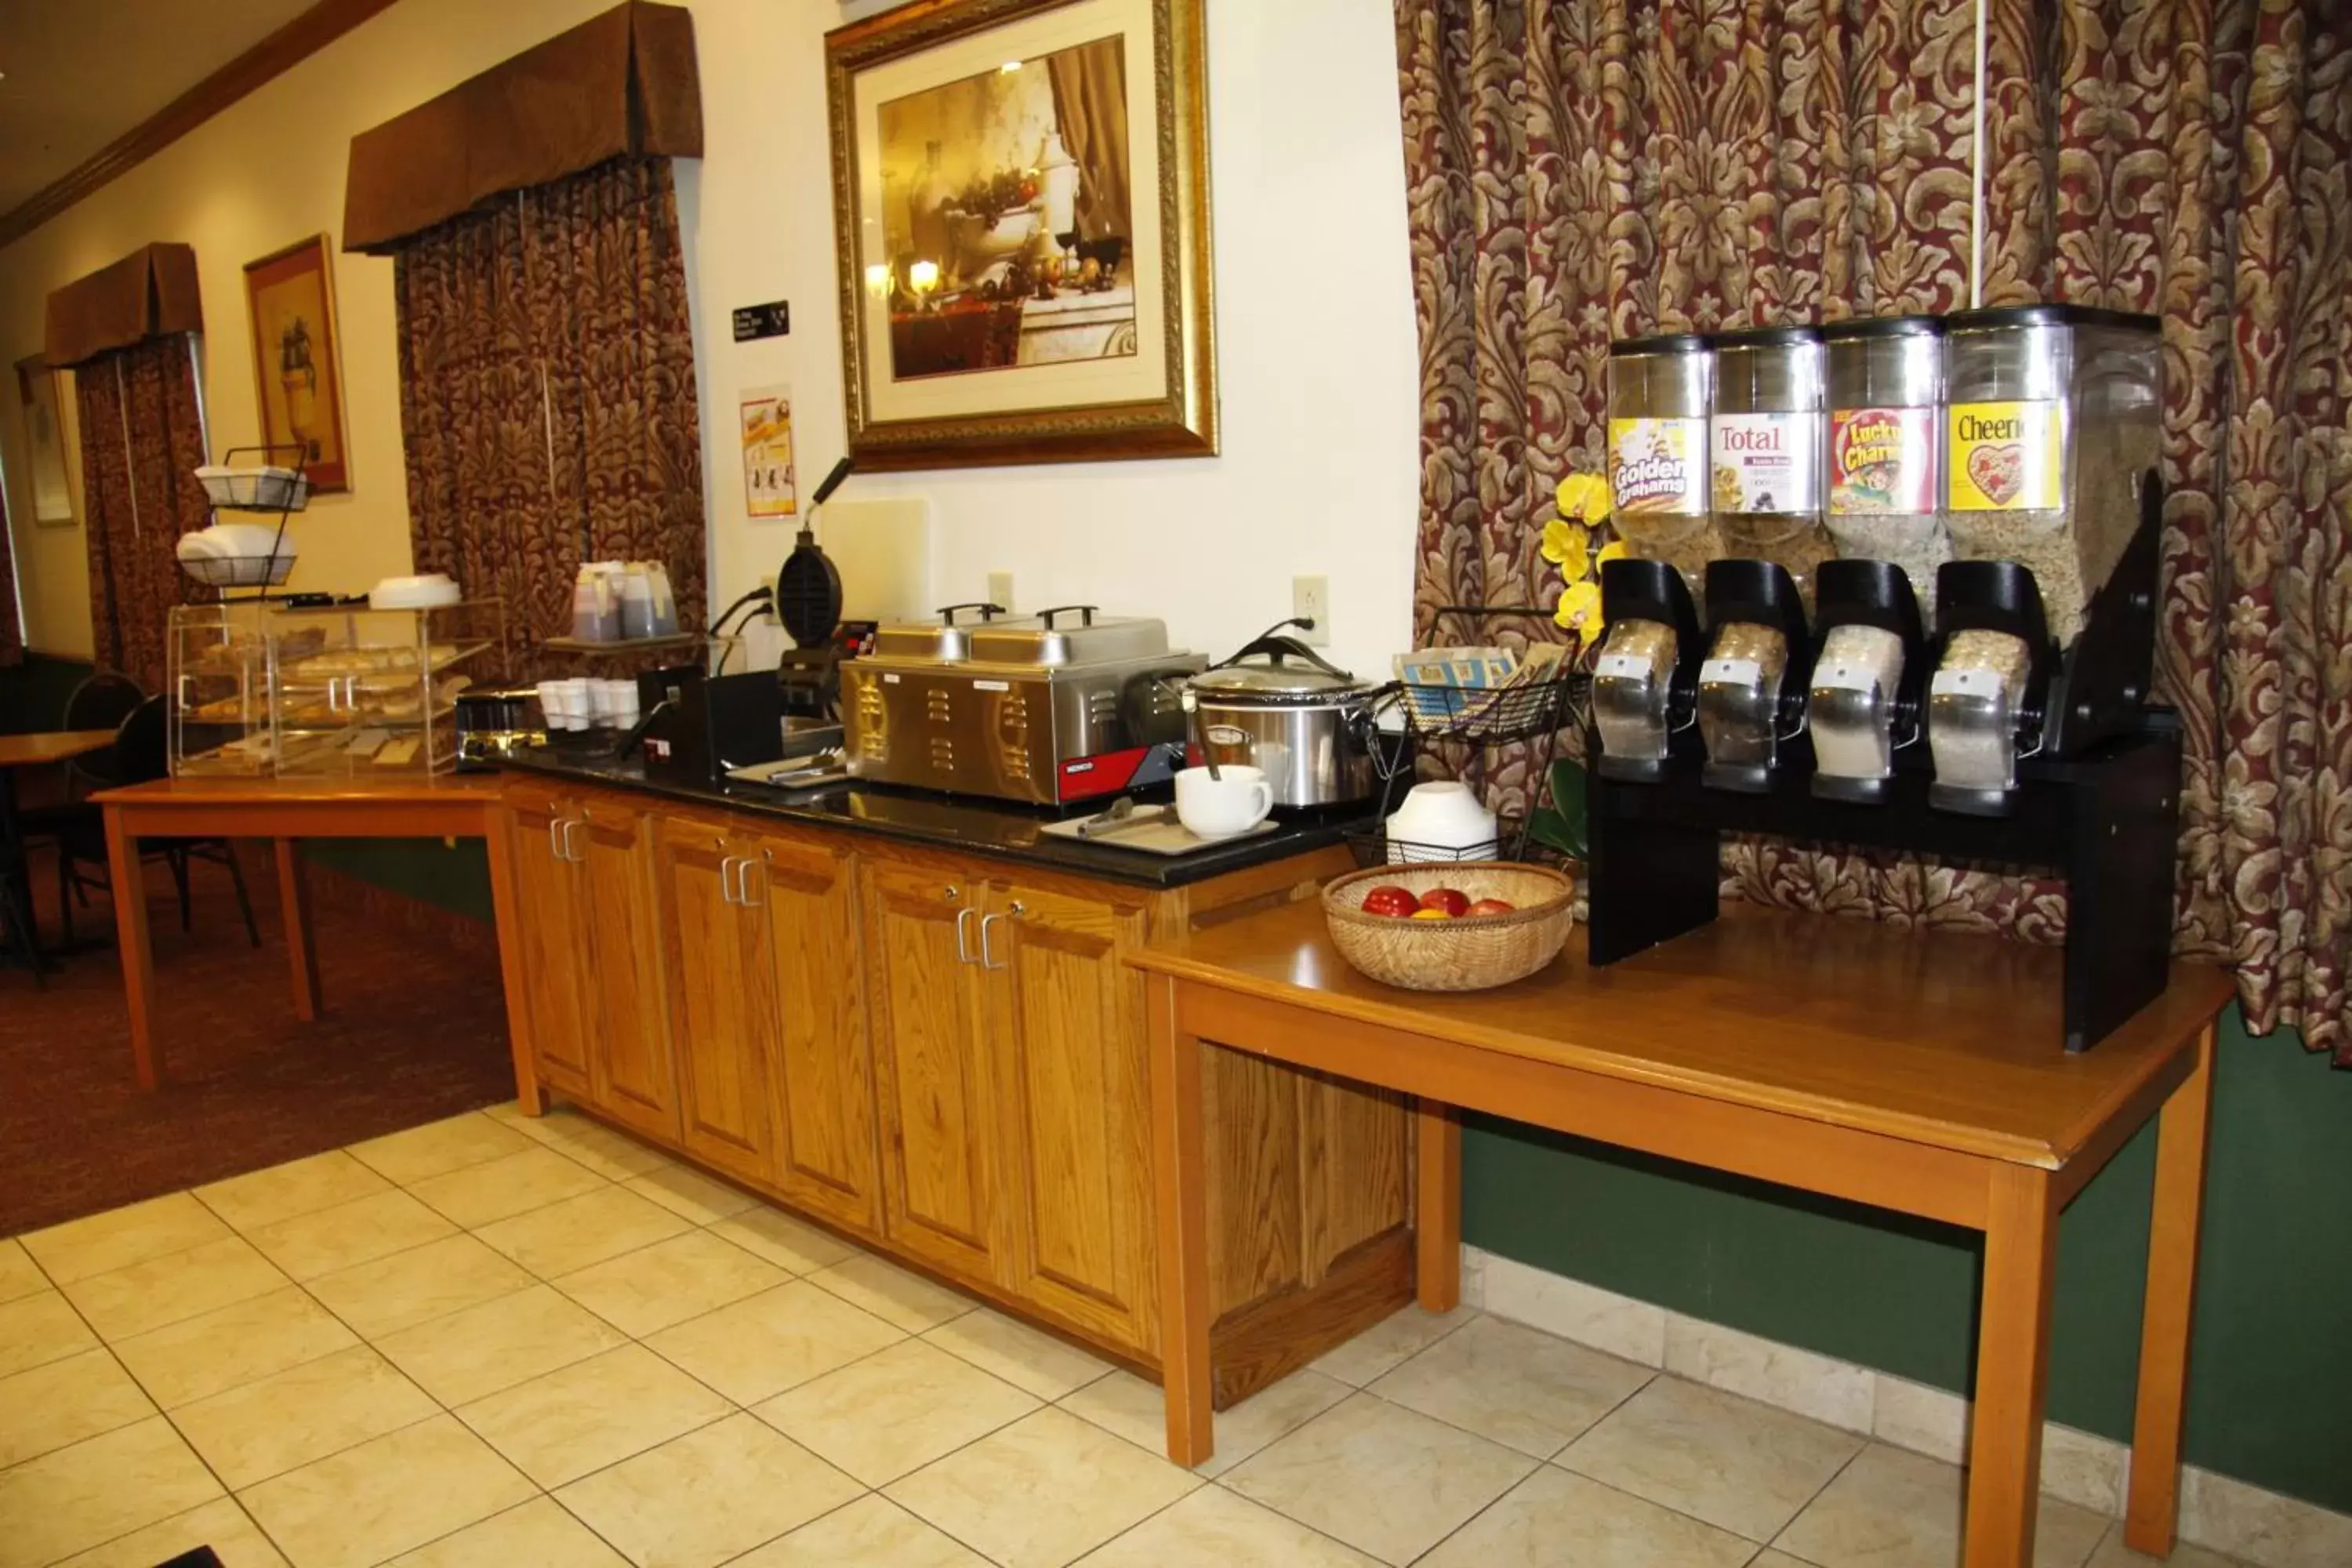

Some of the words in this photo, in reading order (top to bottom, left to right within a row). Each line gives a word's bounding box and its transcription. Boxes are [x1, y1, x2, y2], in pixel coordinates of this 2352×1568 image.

[1721, 426, 1780, 451] Total
[1958, 414, 2043, 441] Cheeri
[1616, 457, 1687, 490] Golden
